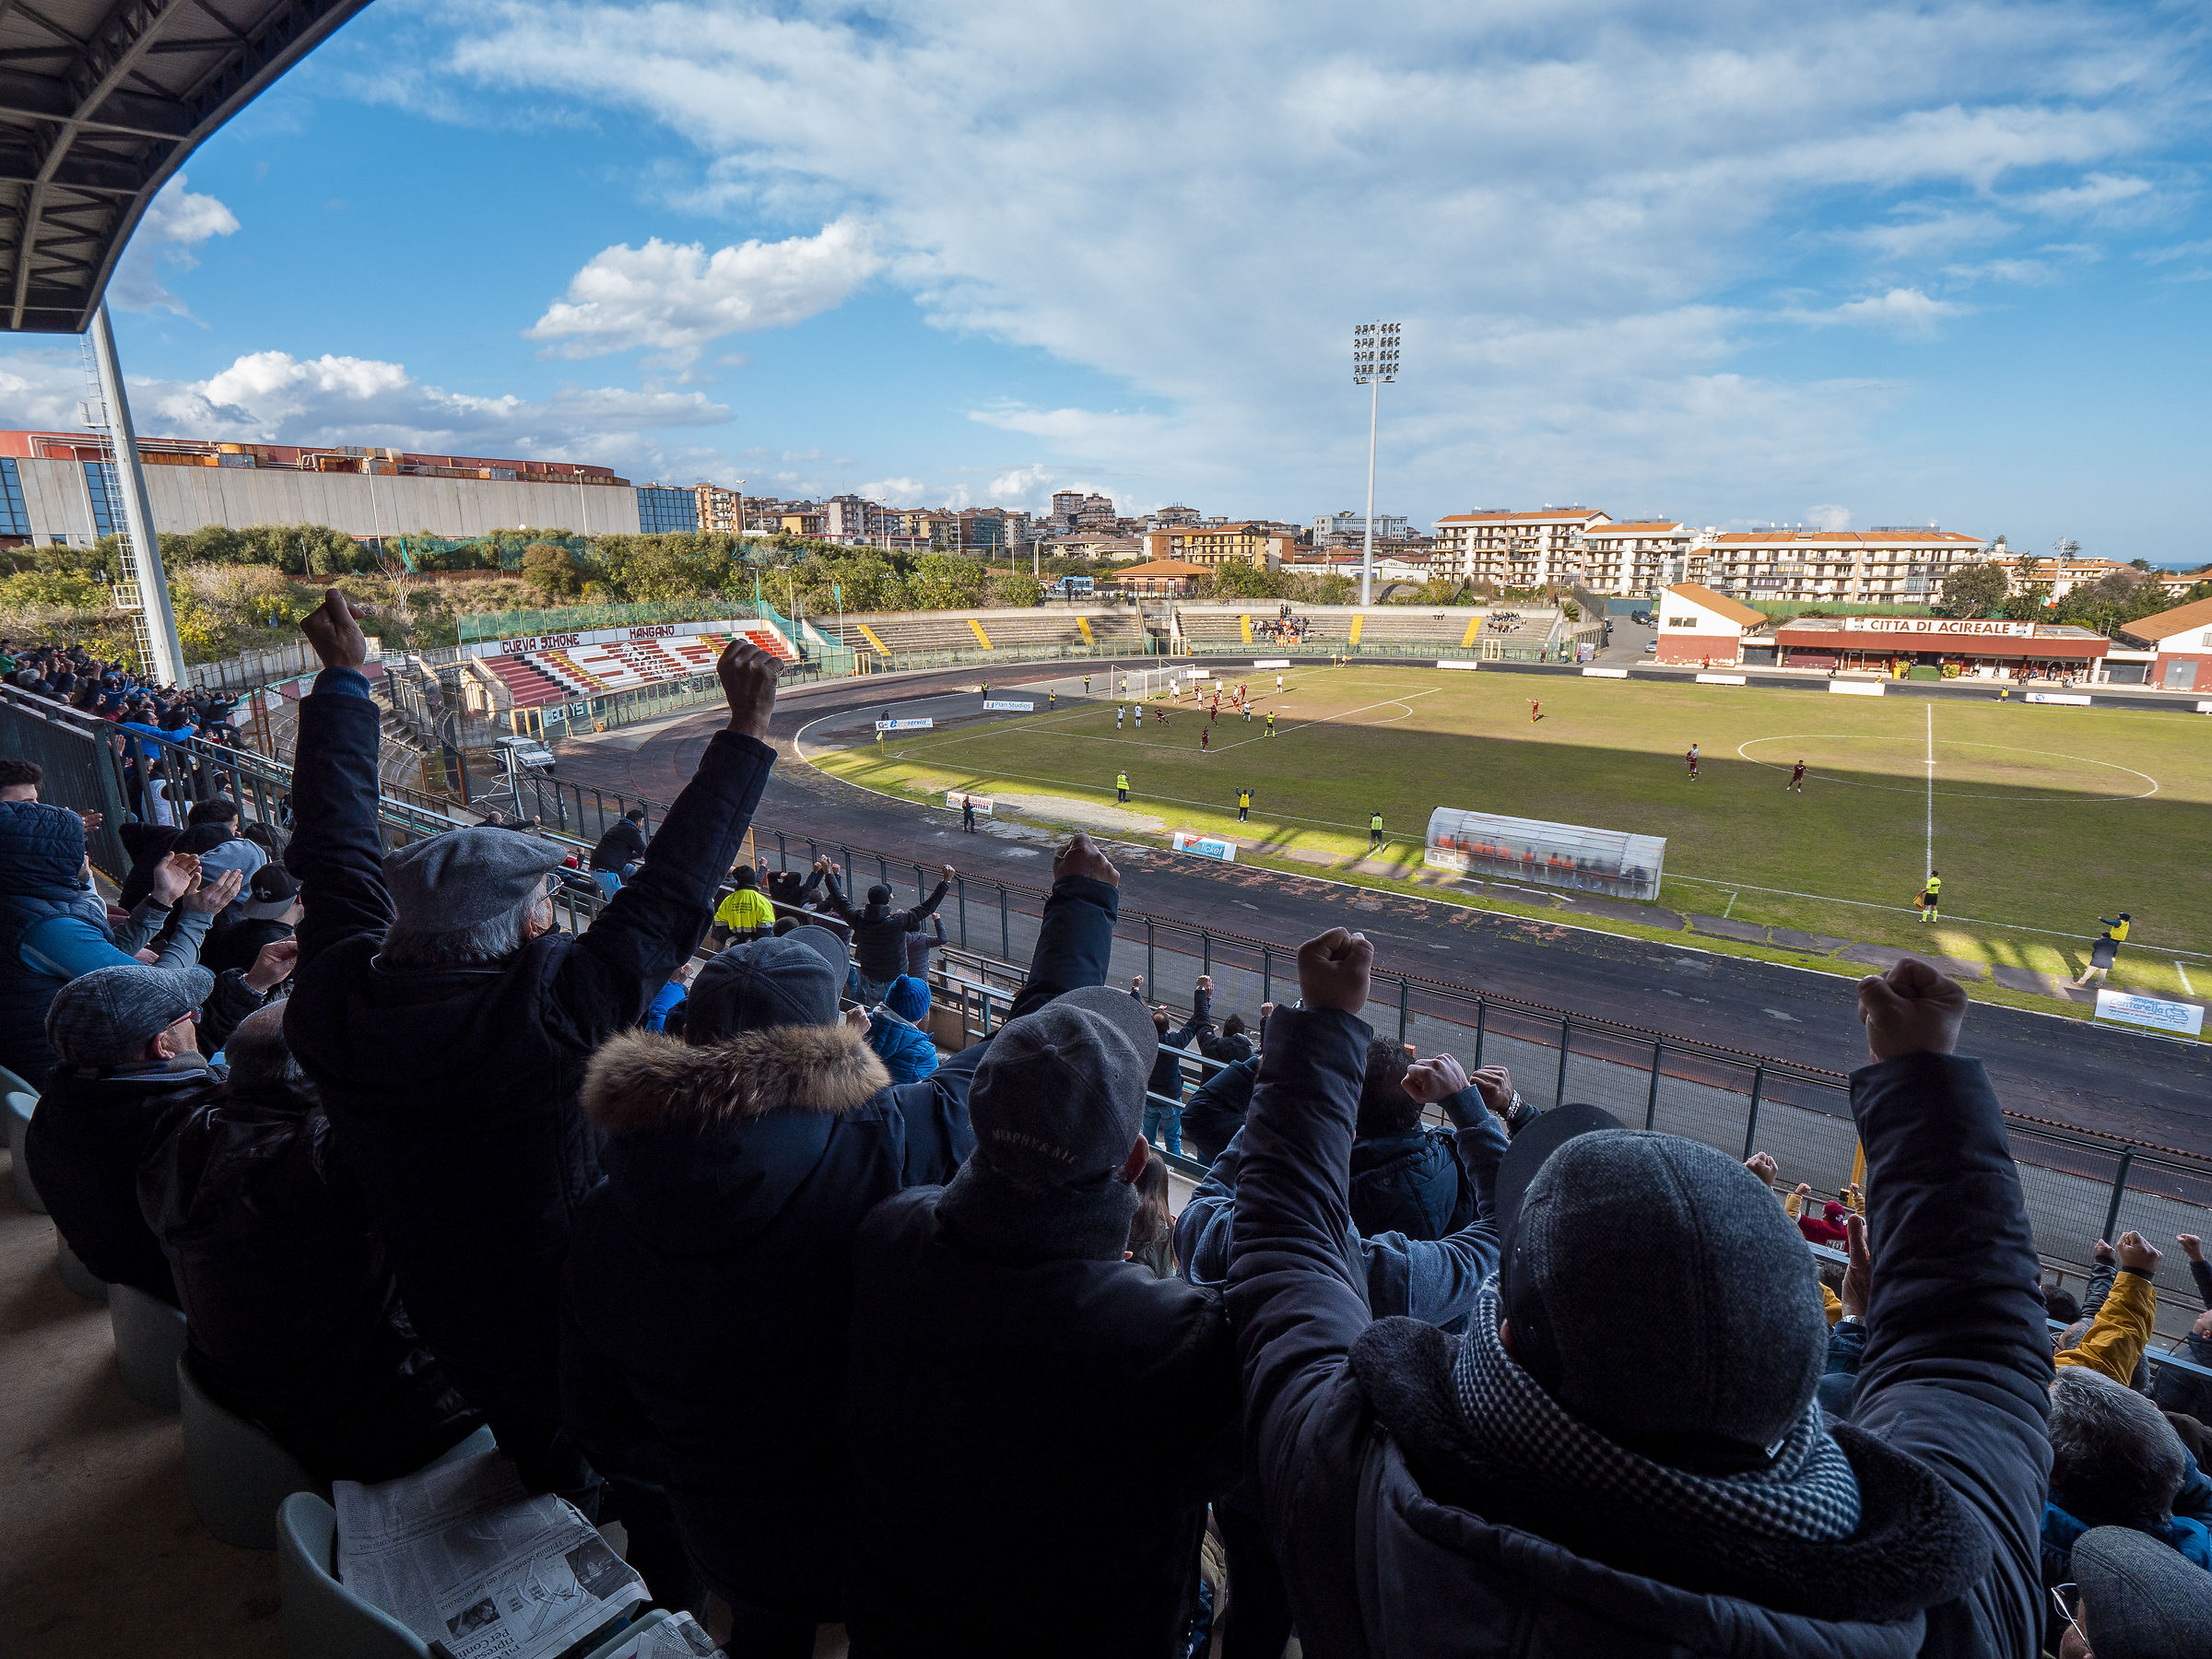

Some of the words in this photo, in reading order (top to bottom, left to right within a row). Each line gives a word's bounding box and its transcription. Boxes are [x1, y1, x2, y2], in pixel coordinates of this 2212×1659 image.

[1917, 622, 1932, 631] DI
[1938, 622, 2010, 634] ACIREALE
[502, 638, 537, 654] CURVA
[629, 626, 675, 640] MANGANO
[497, 1555, 535, 1580] beneficiari
[488, 1628, 510, 1643] Per
